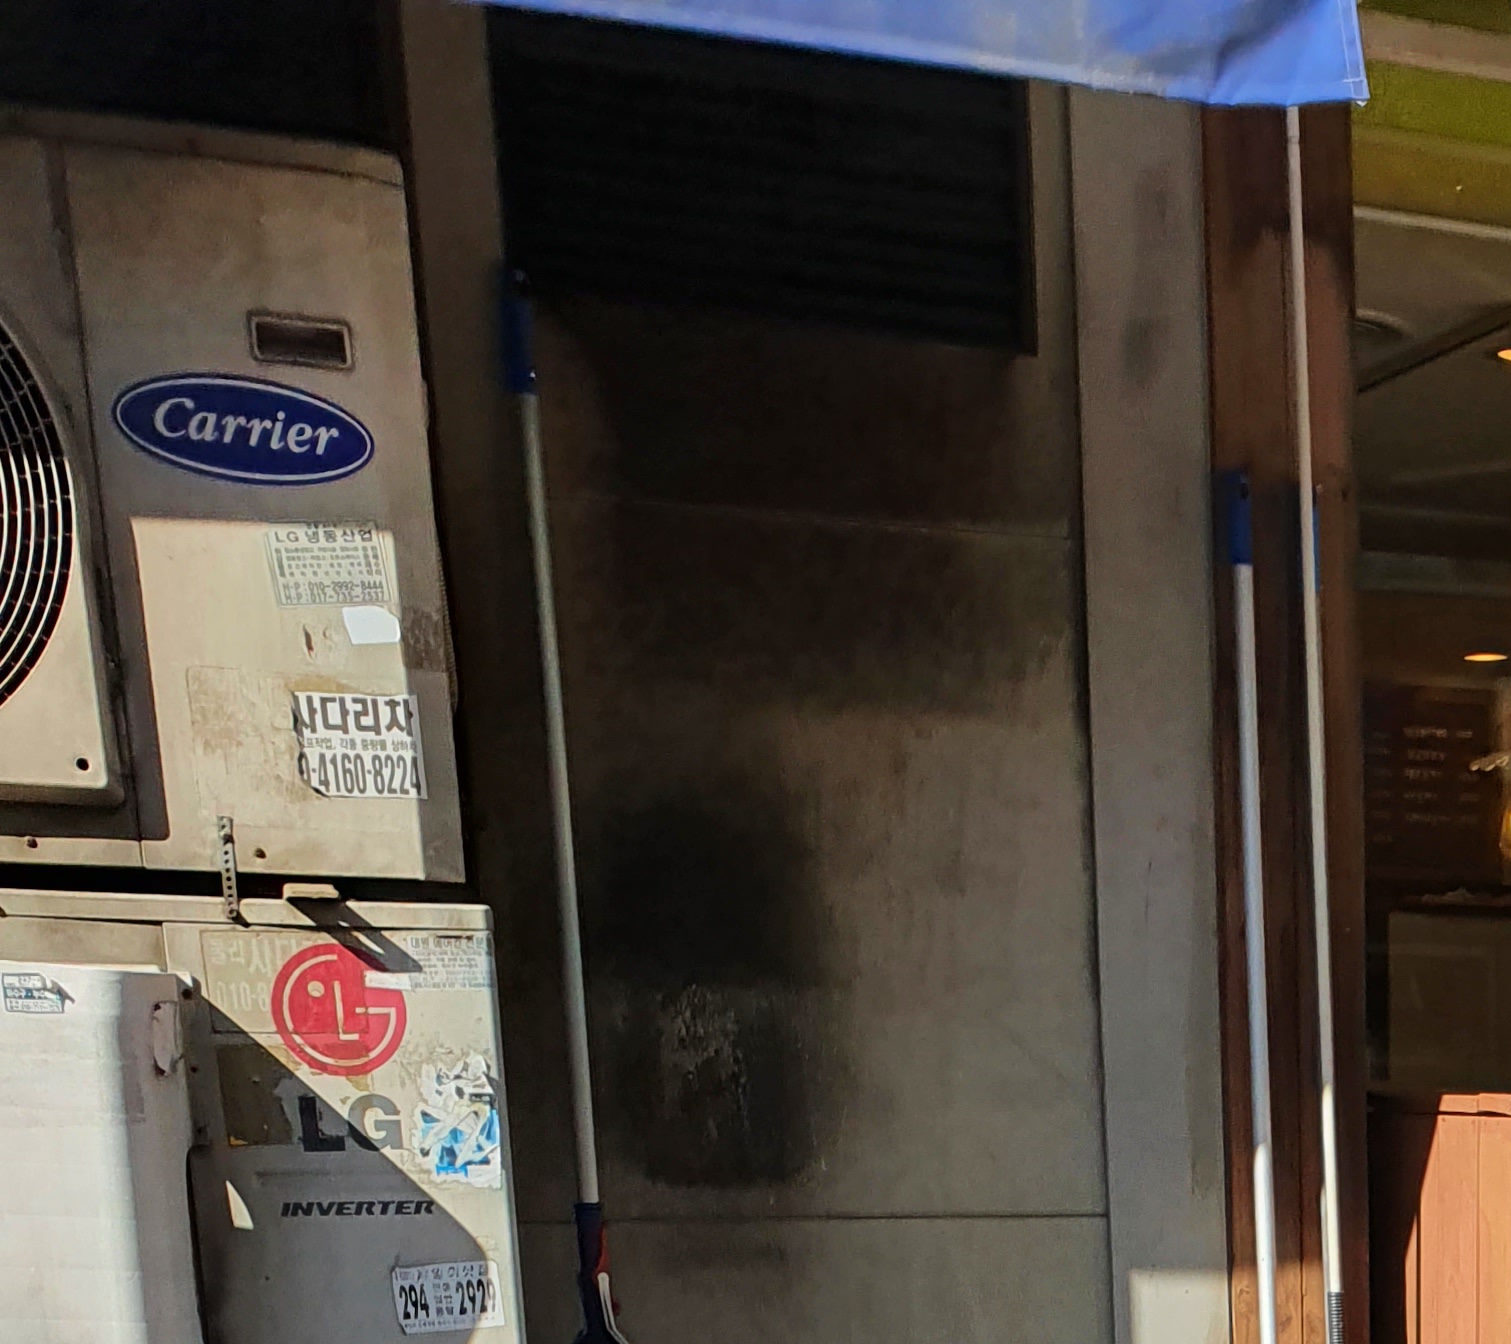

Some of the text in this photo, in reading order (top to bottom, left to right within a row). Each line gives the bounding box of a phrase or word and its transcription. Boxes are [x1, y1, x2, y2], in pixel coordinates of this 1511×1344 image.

[153, 397, 340, 457] Carrier
[274, 530, 300, 544] LG
[300, 1094, 403, 1152] LG
[280, 1200, 436, 1217] INVERTER
[399, 1283, 430, 1320] 294
